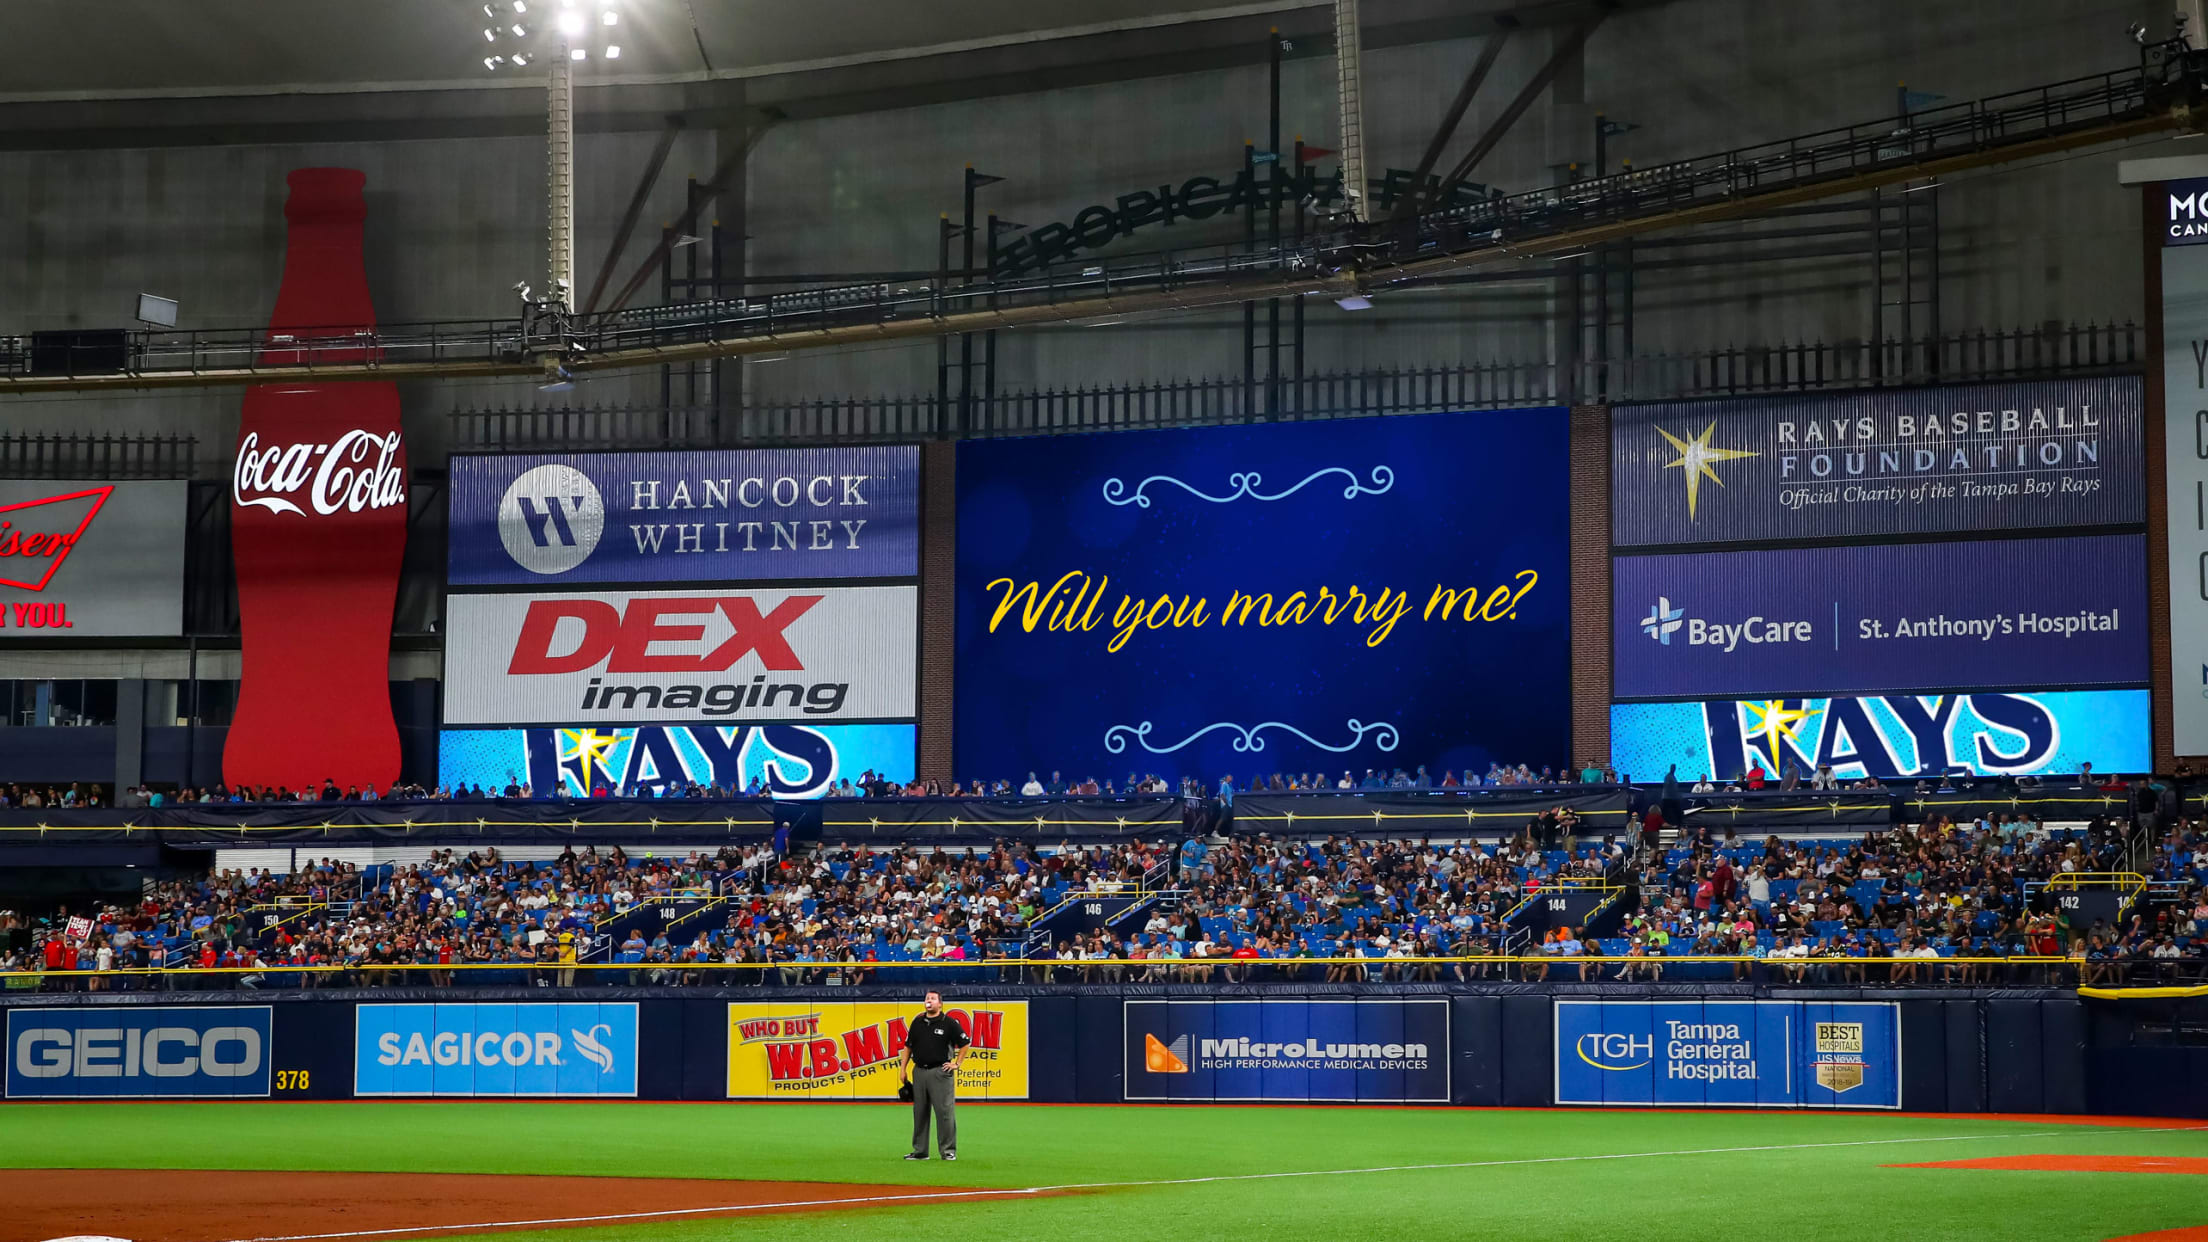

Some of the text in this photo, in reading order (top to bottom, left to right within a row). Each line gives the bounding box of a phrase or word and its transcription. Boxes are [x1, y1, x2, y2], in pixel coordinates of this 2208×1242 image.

[2170, 222, 2208, 237] CAN
[1778, 405, 2099, 443] RAYS BASEBALL
[1781, 440, 2098, 478] FOUNDATION
[234, 429, 405, 517] Coca-Cola
[630, 475, 869, 511] HANCOCK
[1779, 475, 2101, 510] Official Charity of the Tampa Bay Rays
[630, 520, 868, 554] WHITNEY
[13, 602, 73, 628] YOU.
[985, 569, 1539, 653] Will you marry me?
[507, 594, 826, 675] DEX
[1689, 609, 2119, 653] BayCare St. Anthony's Hospital
[581, 675, 849, 716] imaging
[1701, 694, 2061, 780] RAYS
[522, 725, 840, 799] RAYS
[660, 908, 676, 920] 148
[1085, 903, 1102, 916] 146
[1548, 899, 1566, 912] 144
[2059, 896, 2080, 909] 142
[264, 914, 279, 926] 150
[739, 1018, 820, 1040] WHO BUT
[1666, 1020, 1740, 1042] Tampa
[1819, 1025, 1860, 1040] BEST
[16, 1026, 261, 1078] GEICO
[377, 1031, 562, 1067] SAGICOR
[764, 1008, 1004, 1081] W.B.MAON
[1201, 1036, 1428, 1059] MicroLumen
[1587, 1033, 1654, 1059] TGH
[1667, 1040, 1750, 1060] General
[1819, 1041, 1860, 1051] HOSPITALS
[957, 1068, 1001, 1078] Preferred
[1201, 1059, 1428, 1070] HIGH PERFORMANCE MEDICAL DEVICES
[1668, 1060, 1757, 1083] Hospital
[276, 1070, 310, 1091] 378
[774, 1075, 846, 1091] PRODUCTS
[850, 1066, 876, 1080] FOR
[957, 1078, 993, 1088] Partner
